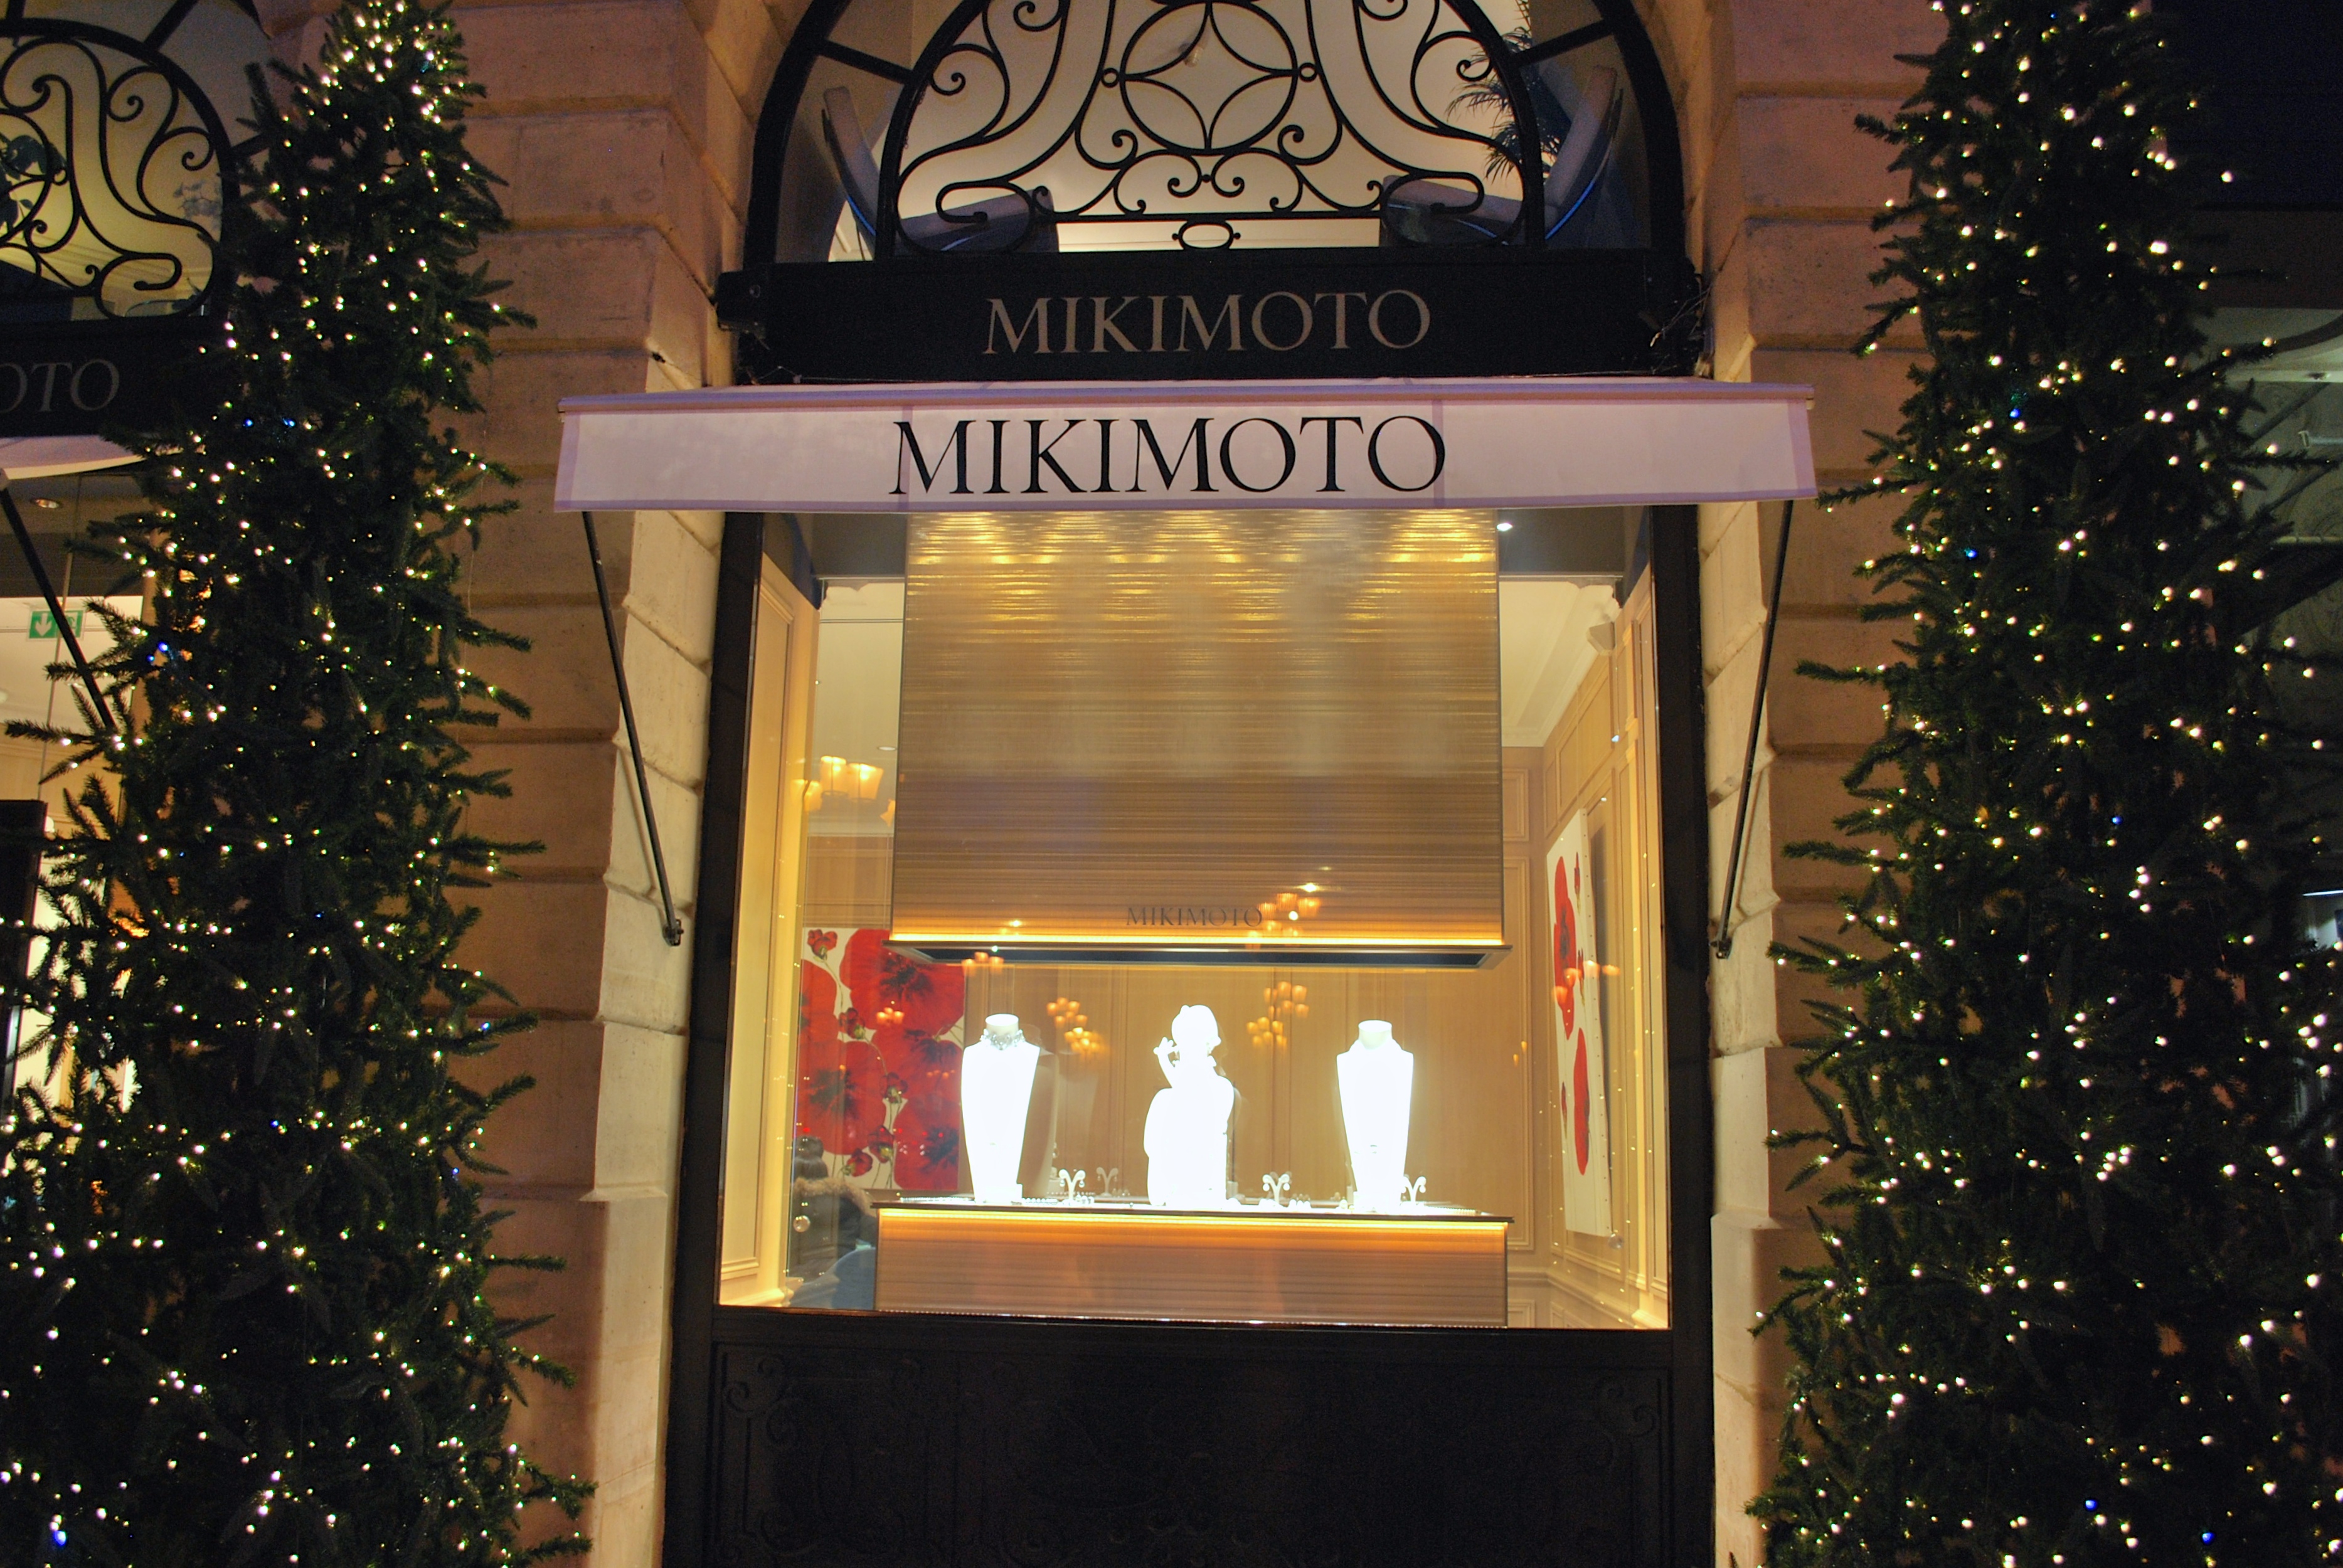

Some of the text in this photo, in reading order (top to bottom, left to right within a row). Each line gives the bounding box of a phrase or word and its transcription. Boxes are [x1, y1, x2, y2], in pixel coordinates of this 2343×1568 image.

[982, 290, 1431, 355] MIKIMOTO
[889, 415, 1446, 494] MIKIMOTO
[1127, 906, 1262, 927] MIKIMOTO
